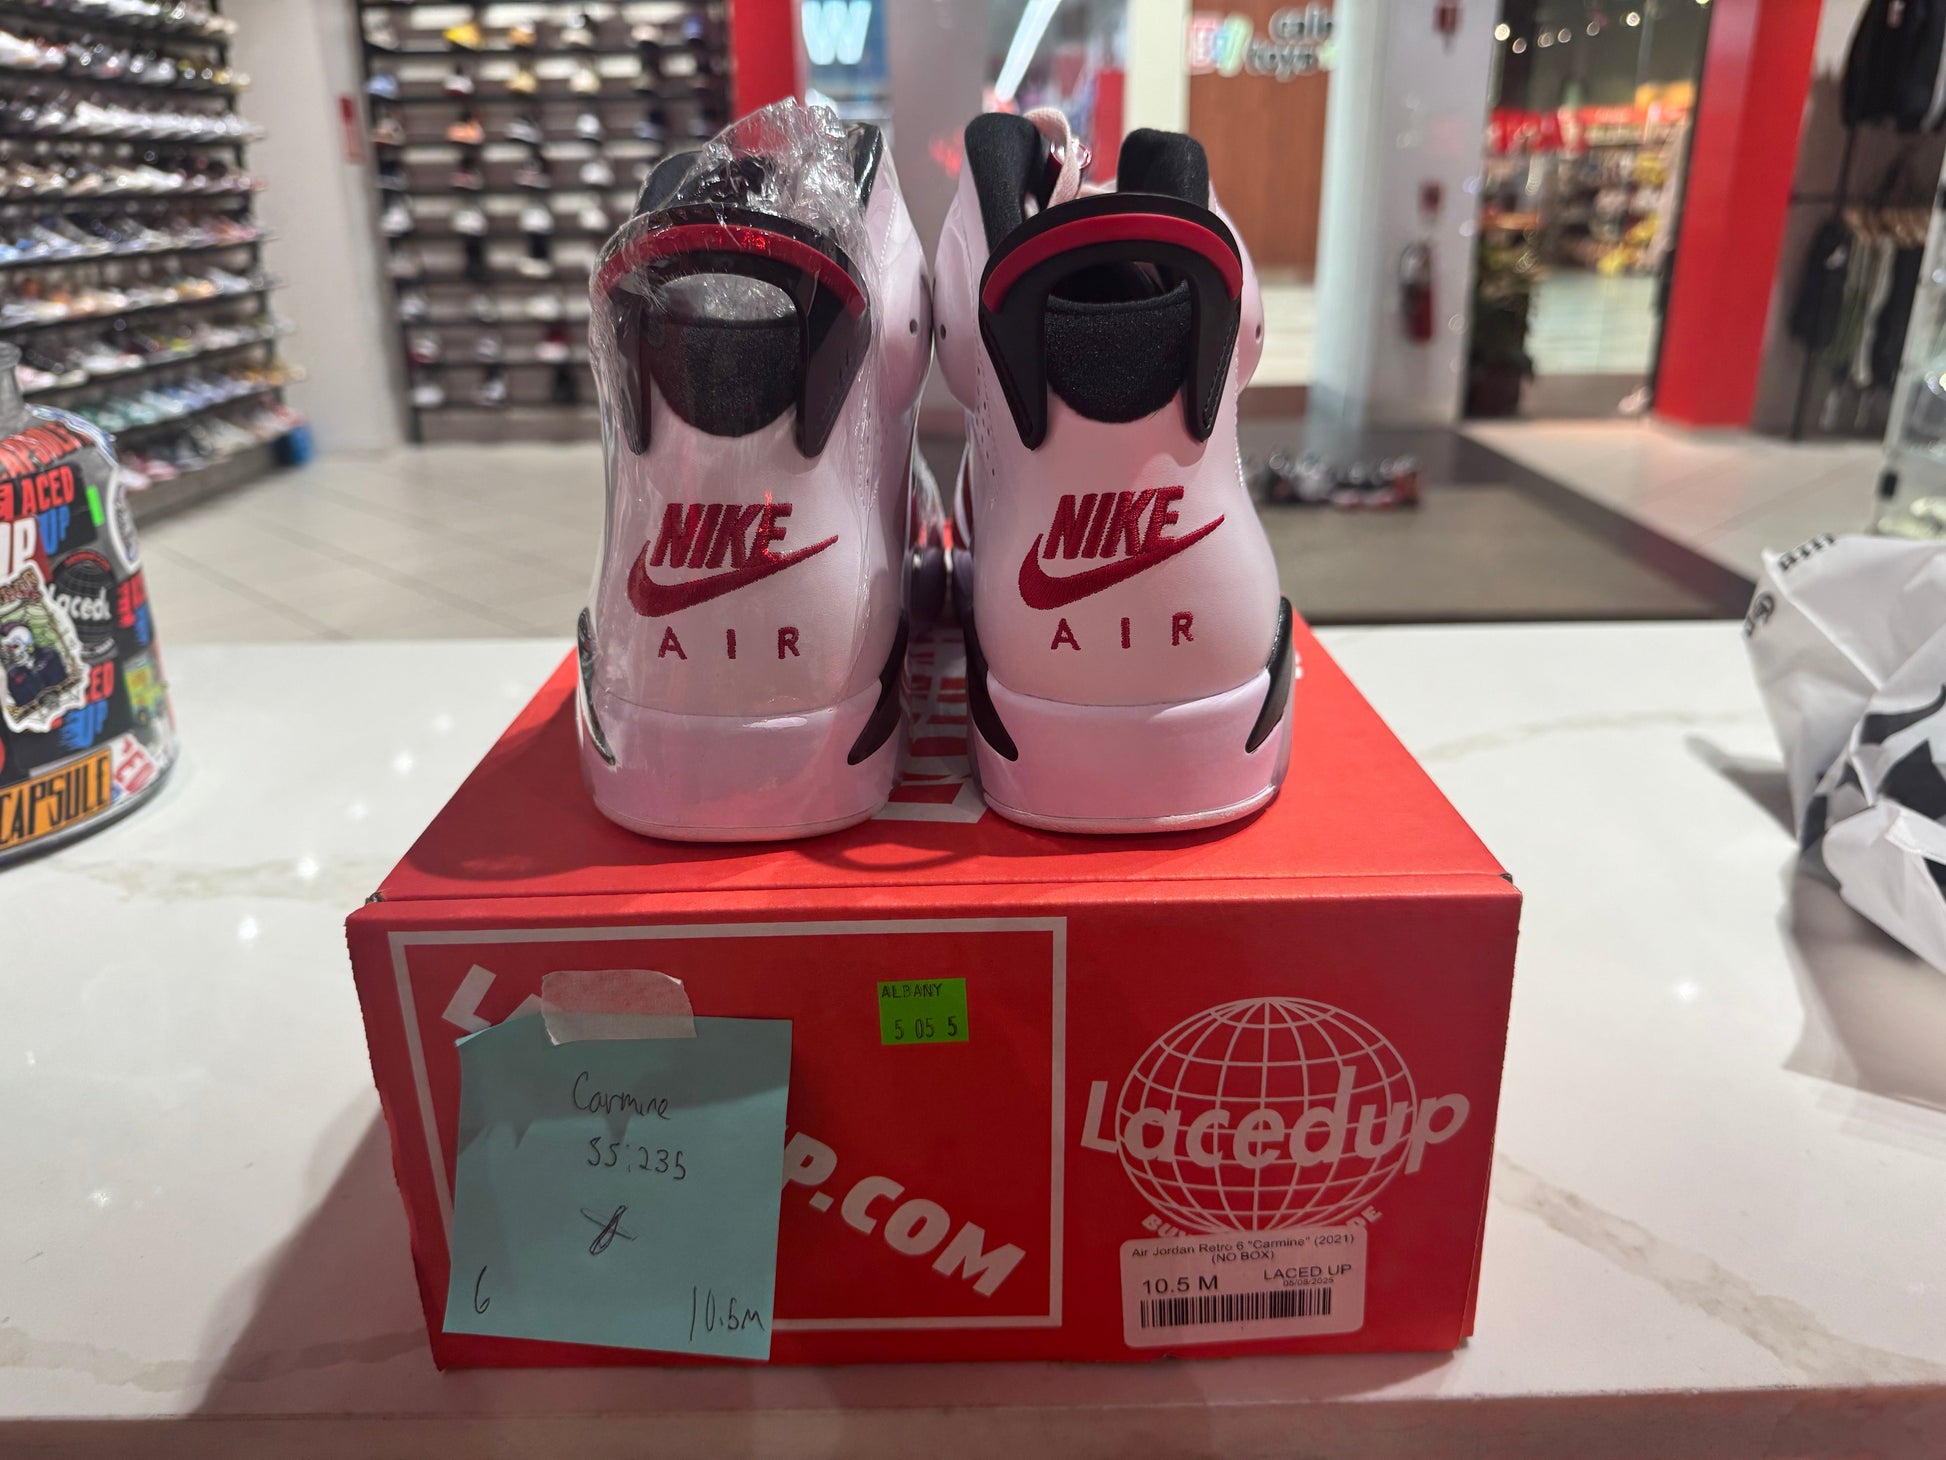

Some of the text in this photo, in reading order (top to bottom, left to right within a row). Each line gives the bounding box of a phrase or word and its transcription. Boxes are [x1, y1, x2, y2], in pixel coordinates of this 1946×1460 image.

[650, 503, 792, 568] NIKE
[1043, 486, 1184, 559] NIKE
[658, 626, 800, 660] AIR
[1051, 611, 1194, 650] AIR
[881, 983, 942, 998] ALBANY
[894, 1019, 904, 1040] 5
[947, 1015, 958, 1037] 5
[1081, 1066, 1470, 1175] Lacedup
[1132, 1234, 1355, 1257] Air Jordan Retro 6 "Carmine" (2021)
[1211, 1249, 1274, 1265] (NO BOX)
[1142, 1275, 1218, 1295] 10.5 M
[1263, 1263, 1352, 1281] LACED UP
[475, 1266, 490, 1314] 6
